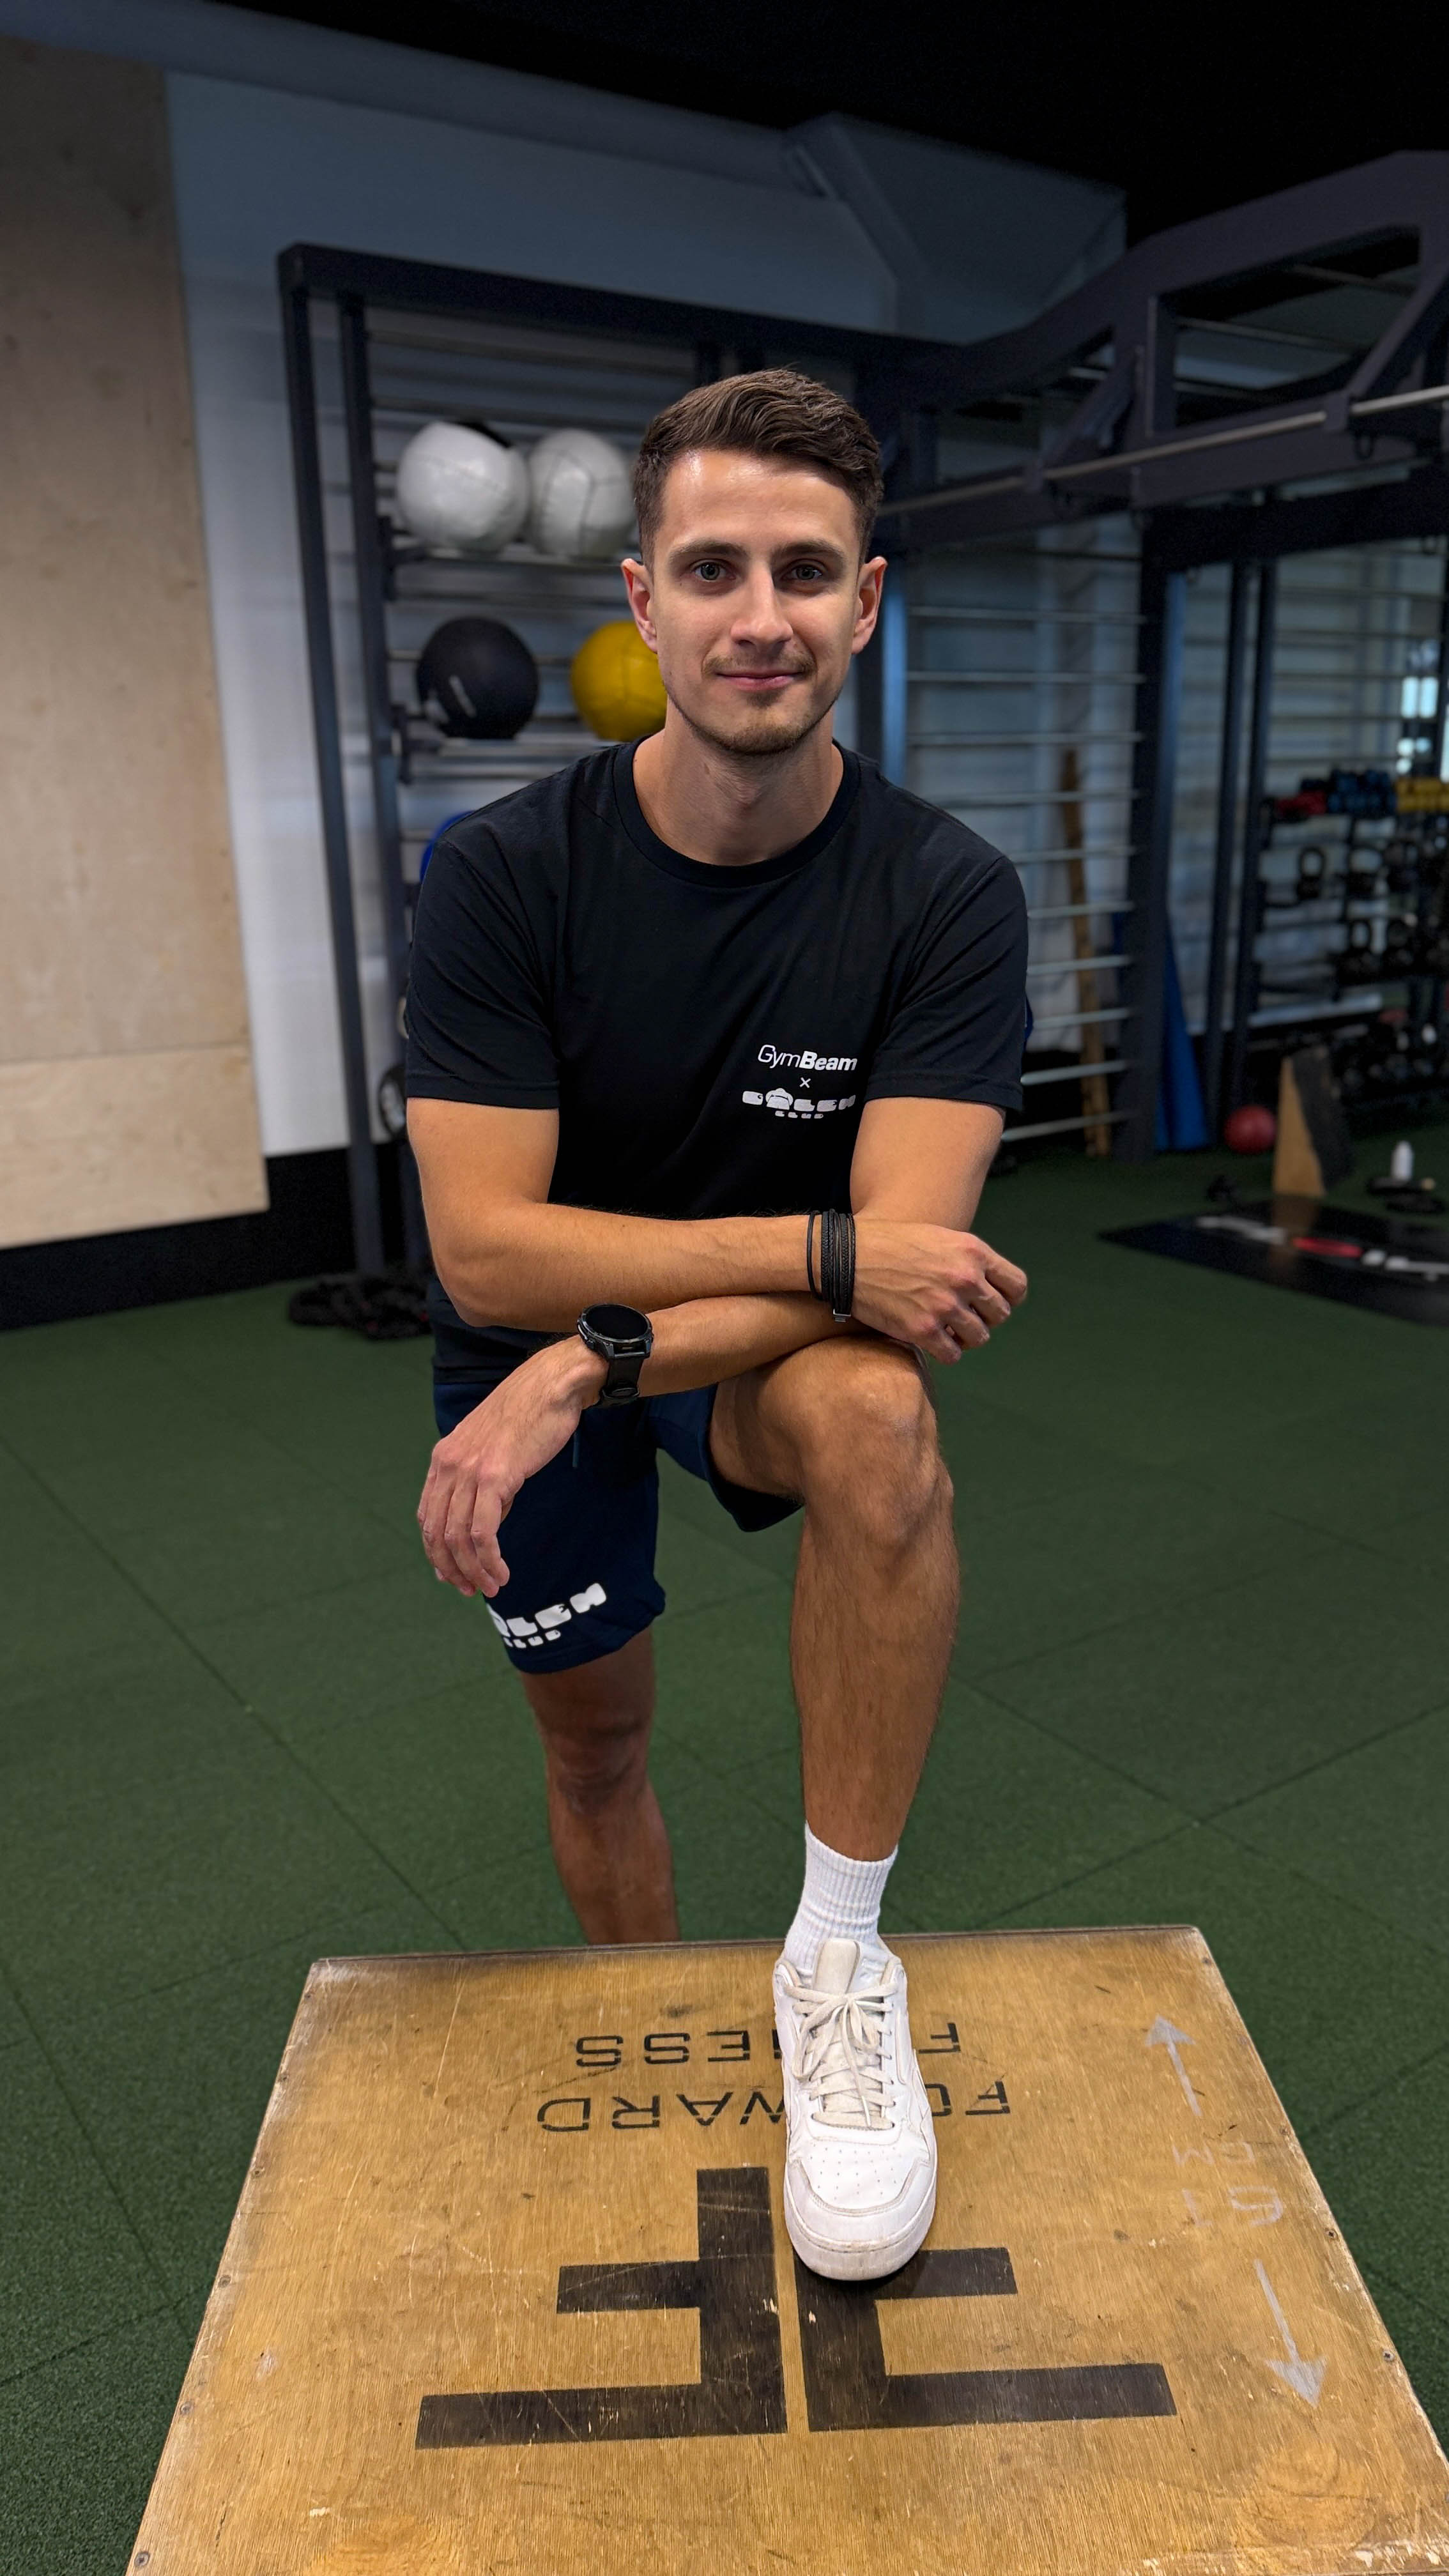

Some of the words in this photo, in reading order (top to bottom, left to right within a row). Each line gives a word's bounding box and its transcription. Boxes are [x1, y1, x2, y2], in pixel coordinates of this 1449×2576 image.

[757, 1044, 857, 1070] GymBeam
[576, 2022, 962, 2067] FESS
[536, 2080, 1011, 2132] FOWARD
